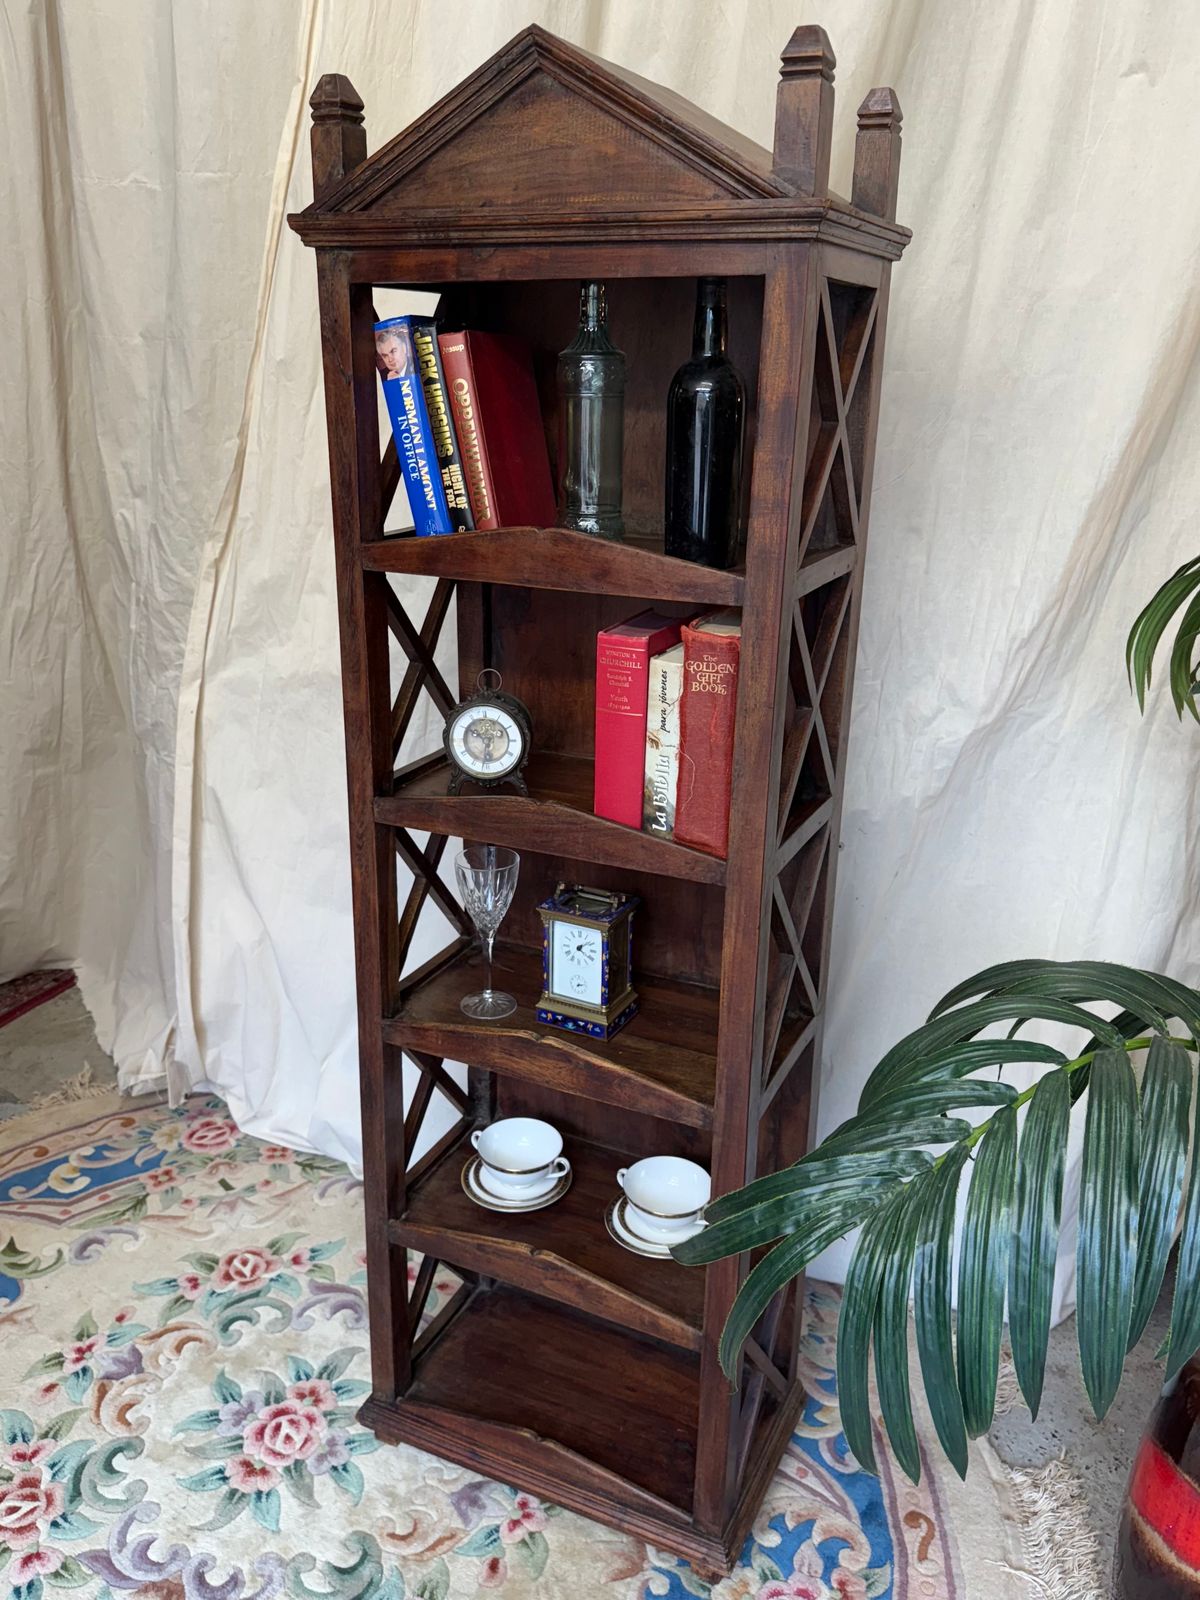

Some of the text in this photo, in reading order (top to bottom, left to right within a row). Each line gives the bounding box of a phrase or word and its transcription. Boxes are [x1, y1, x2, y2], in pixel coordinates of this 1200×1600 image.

[414, 332, 453, 458] JACK HIGGINS
[397, 416, 420, 481] IN OFFICE
[400, 380, 422, 443] NORMAN
[415, 445, 437, 510] LAMONT
[454, 378, 490, 521] OPPENHEIMER
[441, 468, 457, 509] THE FOX
[449, 464, 468, 511] NIGHT OF
[600, 657, 642, 669] CHURCHILL
[685, 661, 735, 673] GOLDEN
[696, 673, 723, 684] GIFT
[703, 654, 717, 662] The
[660, 669, 671, 733] para jóvenes
[691, 682, 727, 695] BOOK
[652, 755, 669, 832] La Biblia
